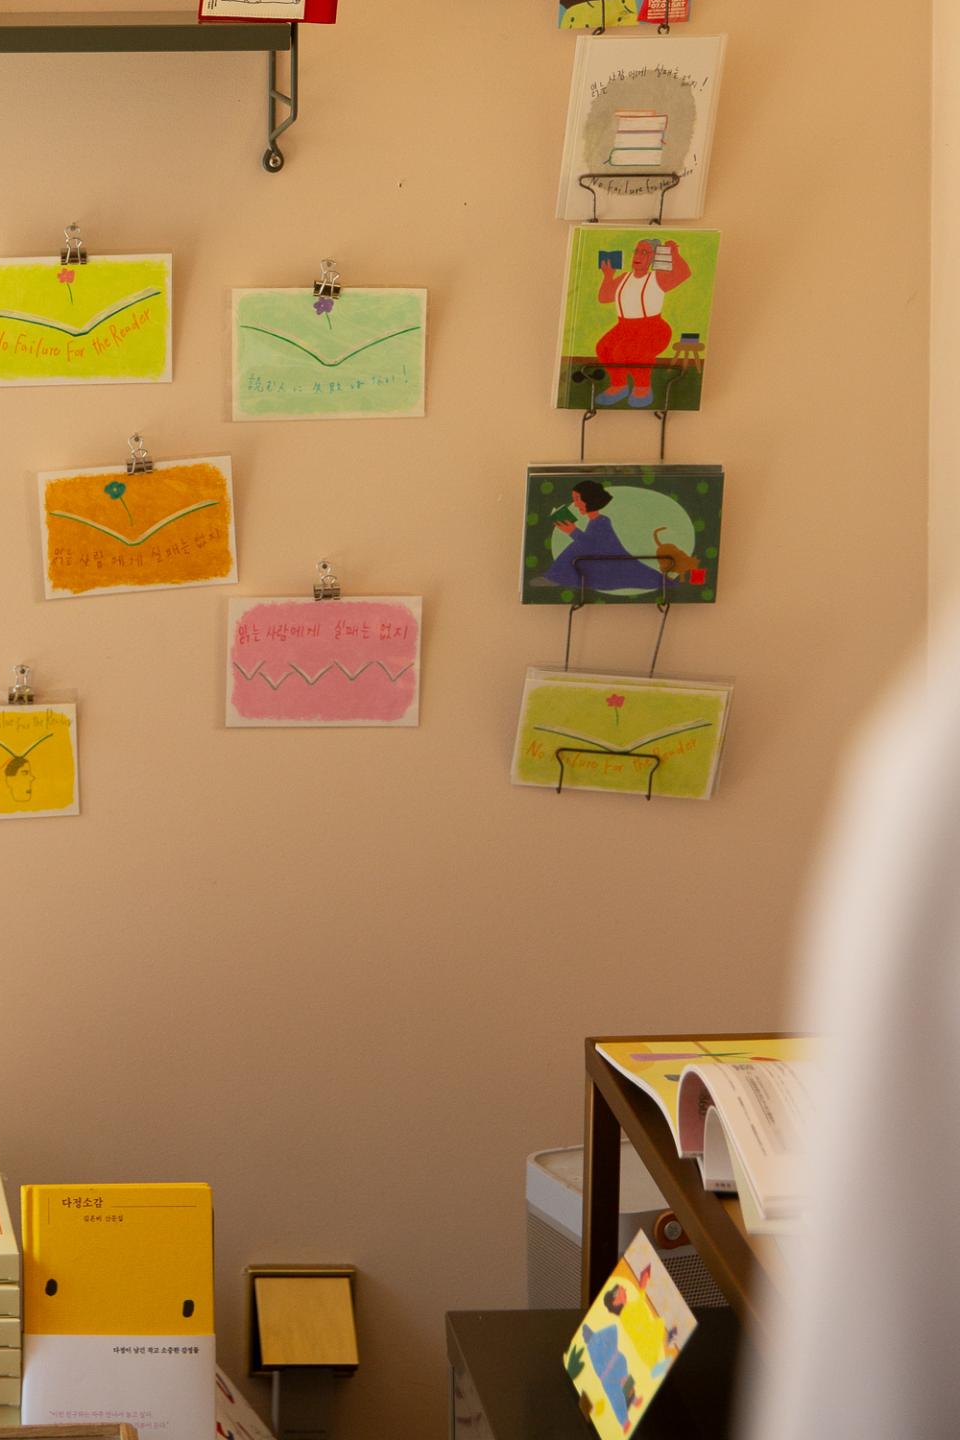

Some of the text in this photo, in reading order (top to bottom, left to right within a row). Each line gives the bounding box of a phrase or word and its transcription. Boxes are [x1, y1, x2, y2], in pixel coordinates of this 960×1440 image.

[14, 333, 61, 358] Failure
[92, 336, 111, 356] the
[110, 308, 151, 347] Reader
[238, 623, 261, 645] 읽는
[380, 622, 409, 641] 없지
[62, 1197, 104, 1208] 다정소감
